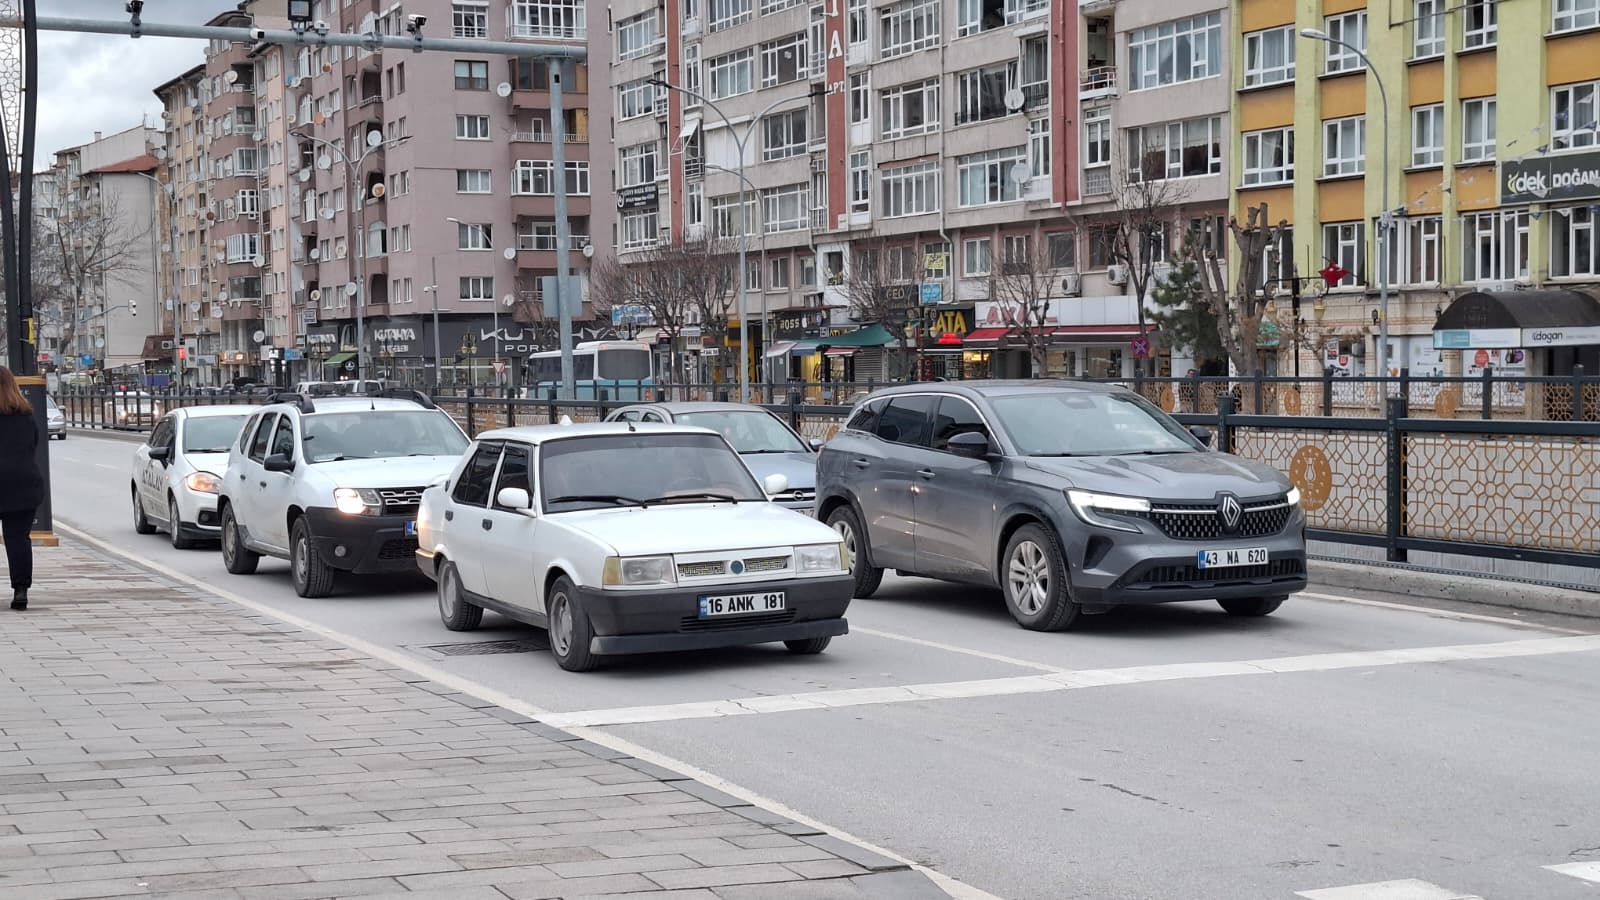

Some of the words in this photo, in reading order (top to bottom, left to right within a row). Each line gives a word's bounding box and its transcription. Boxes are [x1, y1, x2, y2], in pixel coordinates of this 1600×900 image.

[936, 311, 967, 335] ATA
[1206, 552, 1218, 565] 43
[1227, 551, 1239, 565] NA
[1248, 549, 1266, 563] 620
[708, 598, 722, 613] 16
[728, 596, 754, 612] ANK
[763, 594, 784, 609] 181
